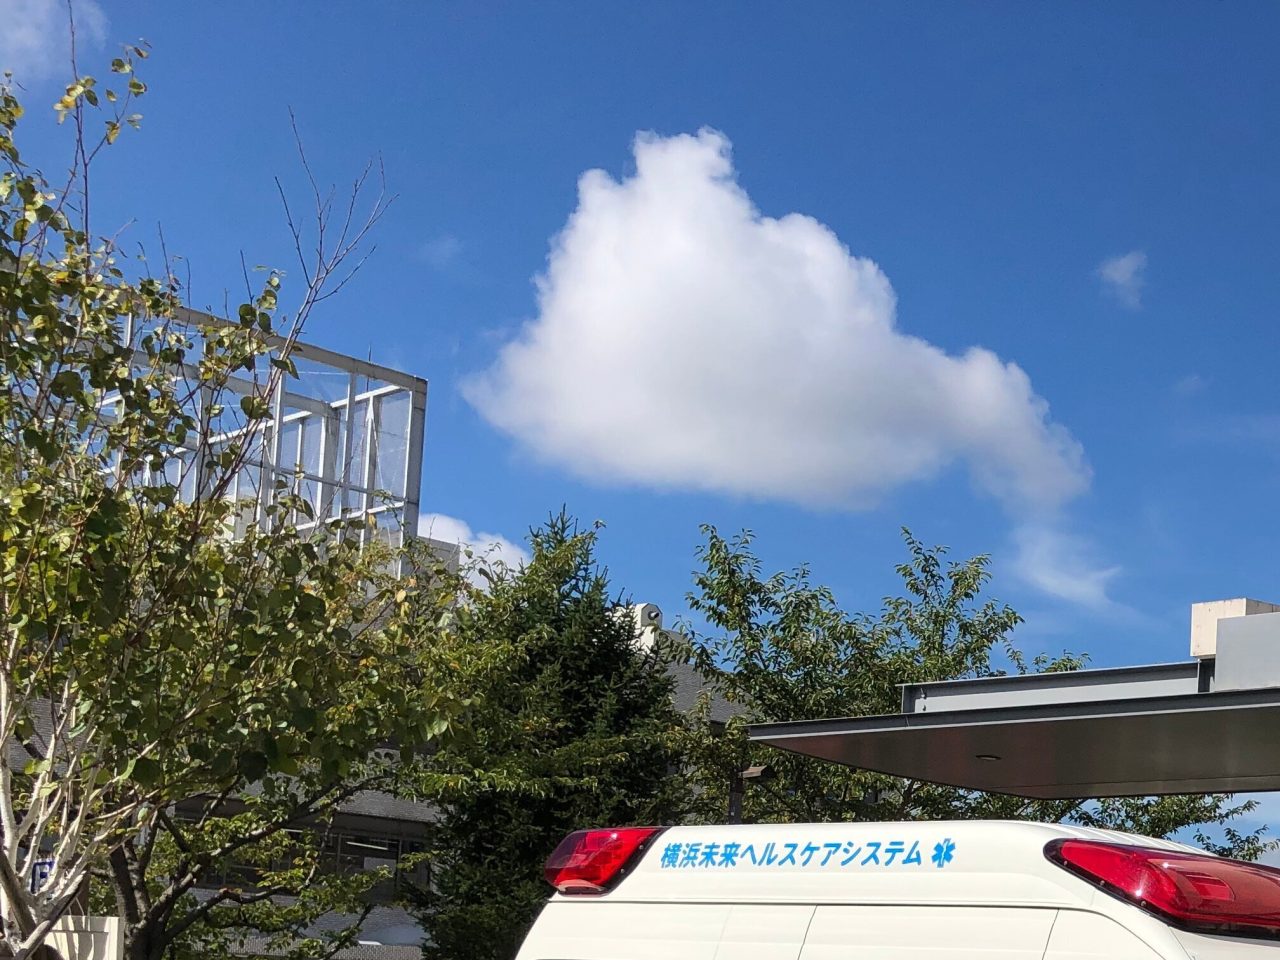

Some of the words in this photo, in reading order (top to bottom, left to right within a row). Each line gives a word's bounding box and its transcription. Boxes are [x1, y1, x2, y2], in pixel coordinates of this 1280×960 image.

[660, 840, 922, 868] 横浜未来ヘルスケアシステム
